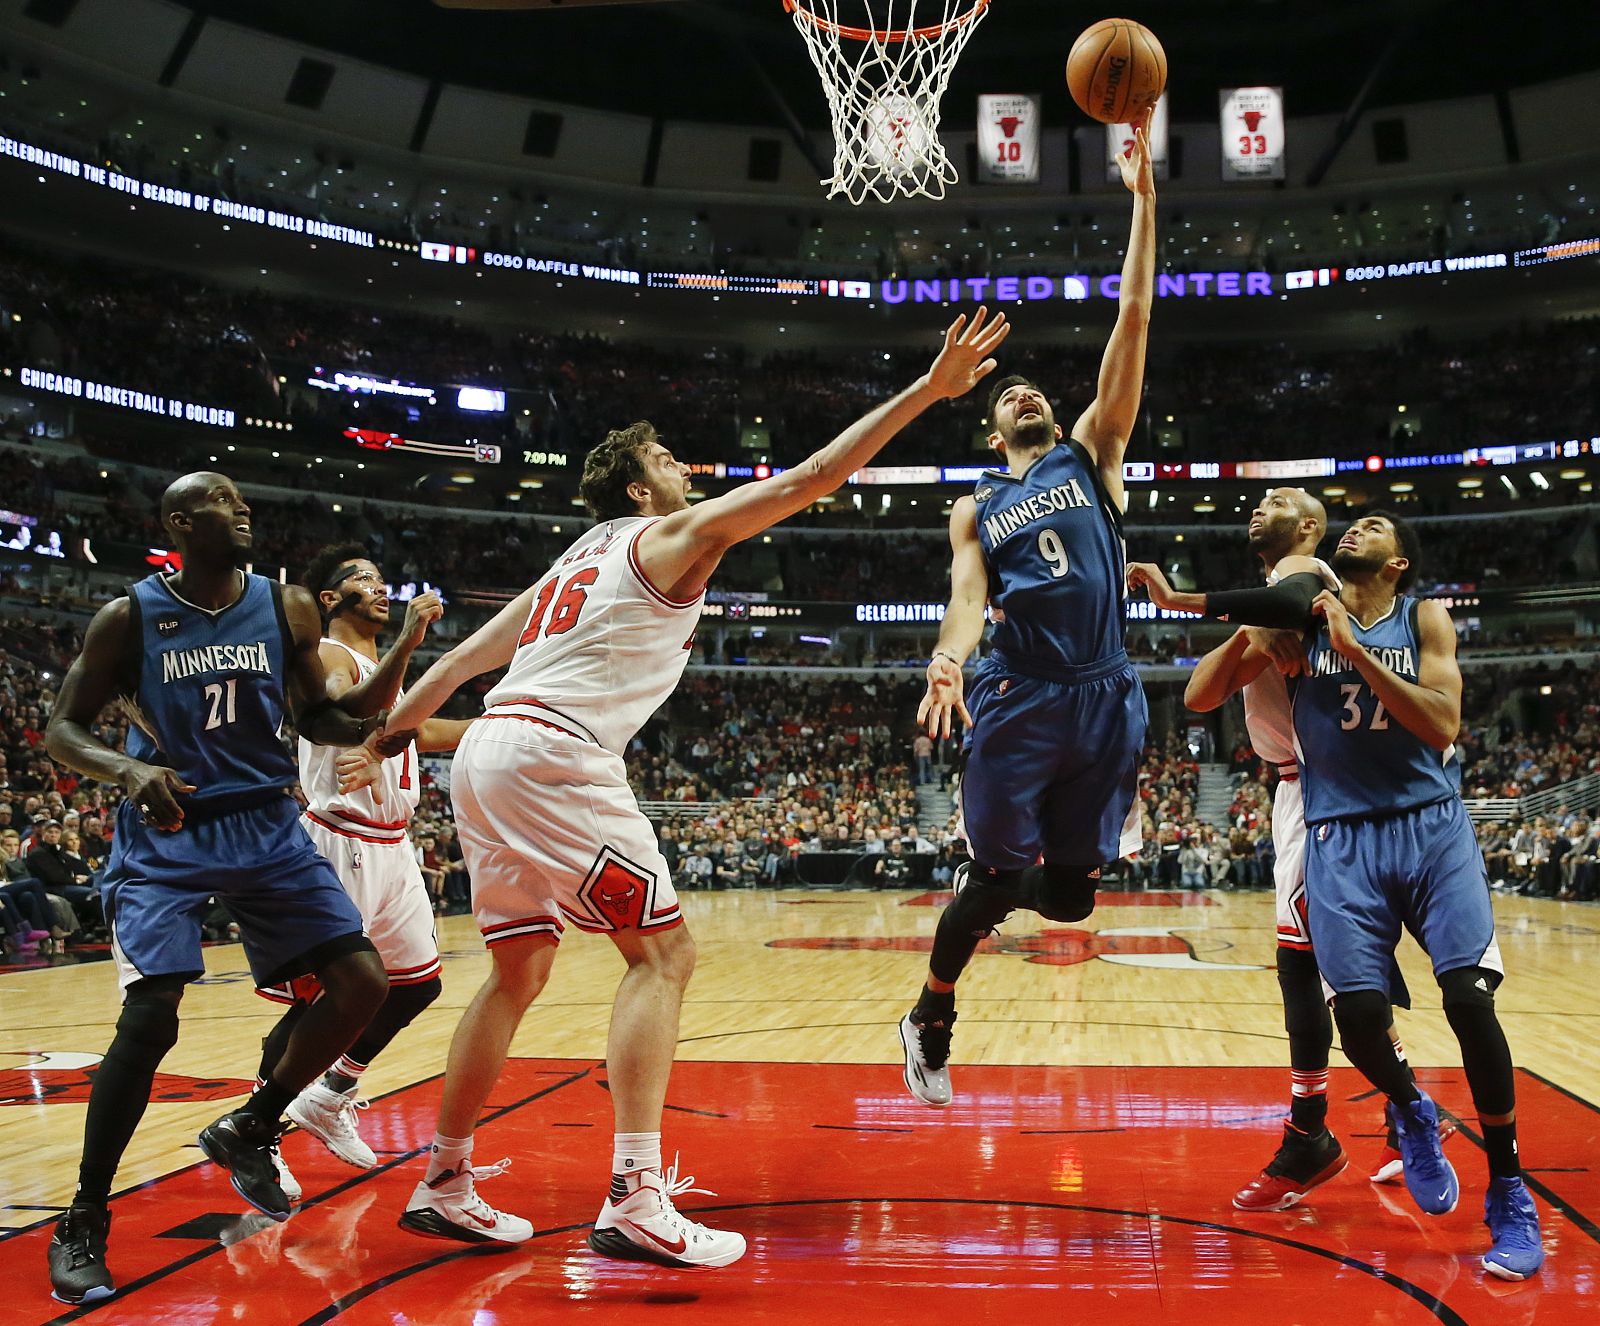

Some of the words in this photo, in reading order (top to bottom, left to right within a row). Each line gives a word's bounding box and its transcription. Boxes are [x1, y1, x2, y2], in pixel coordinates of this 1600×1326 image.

[998, 142, 1021, 161] 10
[1239, 135, 1266, 154] 33
[0, 136, 80, 177] CELEBRATING
[83, 164, 106, 185] THE
[109, 168, 139, 196] 50TH
[143, 183, 191, 208] SEASON
[194, 195, 210, 212] OF
[213, 199, 265, 224] CHICAGO
[268, 211, 303, 233] BULLS
[306, 220, 374, 248] BASKETBALL
[484, 252, 523, 269] 5050
[527, 257, 578, 276] RAFFLE
[582, 265, 640, 284] WINNER
[1346, 265, 1385, 281] 5050
[1388, 260, 1442, 277] RAFFLE
[1445, 254, 1507, 271] WINNER
[881, 276, 1054, 304] UNITED
[1099, 271, 1273, 299] CNTER
[21, 367, 82, 396] CHICAGO
[86, 381, 165, 415] BASKETBALL
[169, 400, 182, 418] IS
[186, 403, 235, 428] GOLDEN
[523, 450, 548, 464] 7:09
[547, 453, 567, 466] PM
[1385, 457, 1430, 468] HARRIS
[984, 478, 1093, 549] MINNESOTA
[1038, 528, 1069, 578] 9
[518, 566, 599, 649] 16
[856, 604, 945, 621] CELEBRATING
[158, 621, 178, 631] FLIP
[162, 641, 272, 684] MINNESOTA
[204, 678, 238, 731] 21
